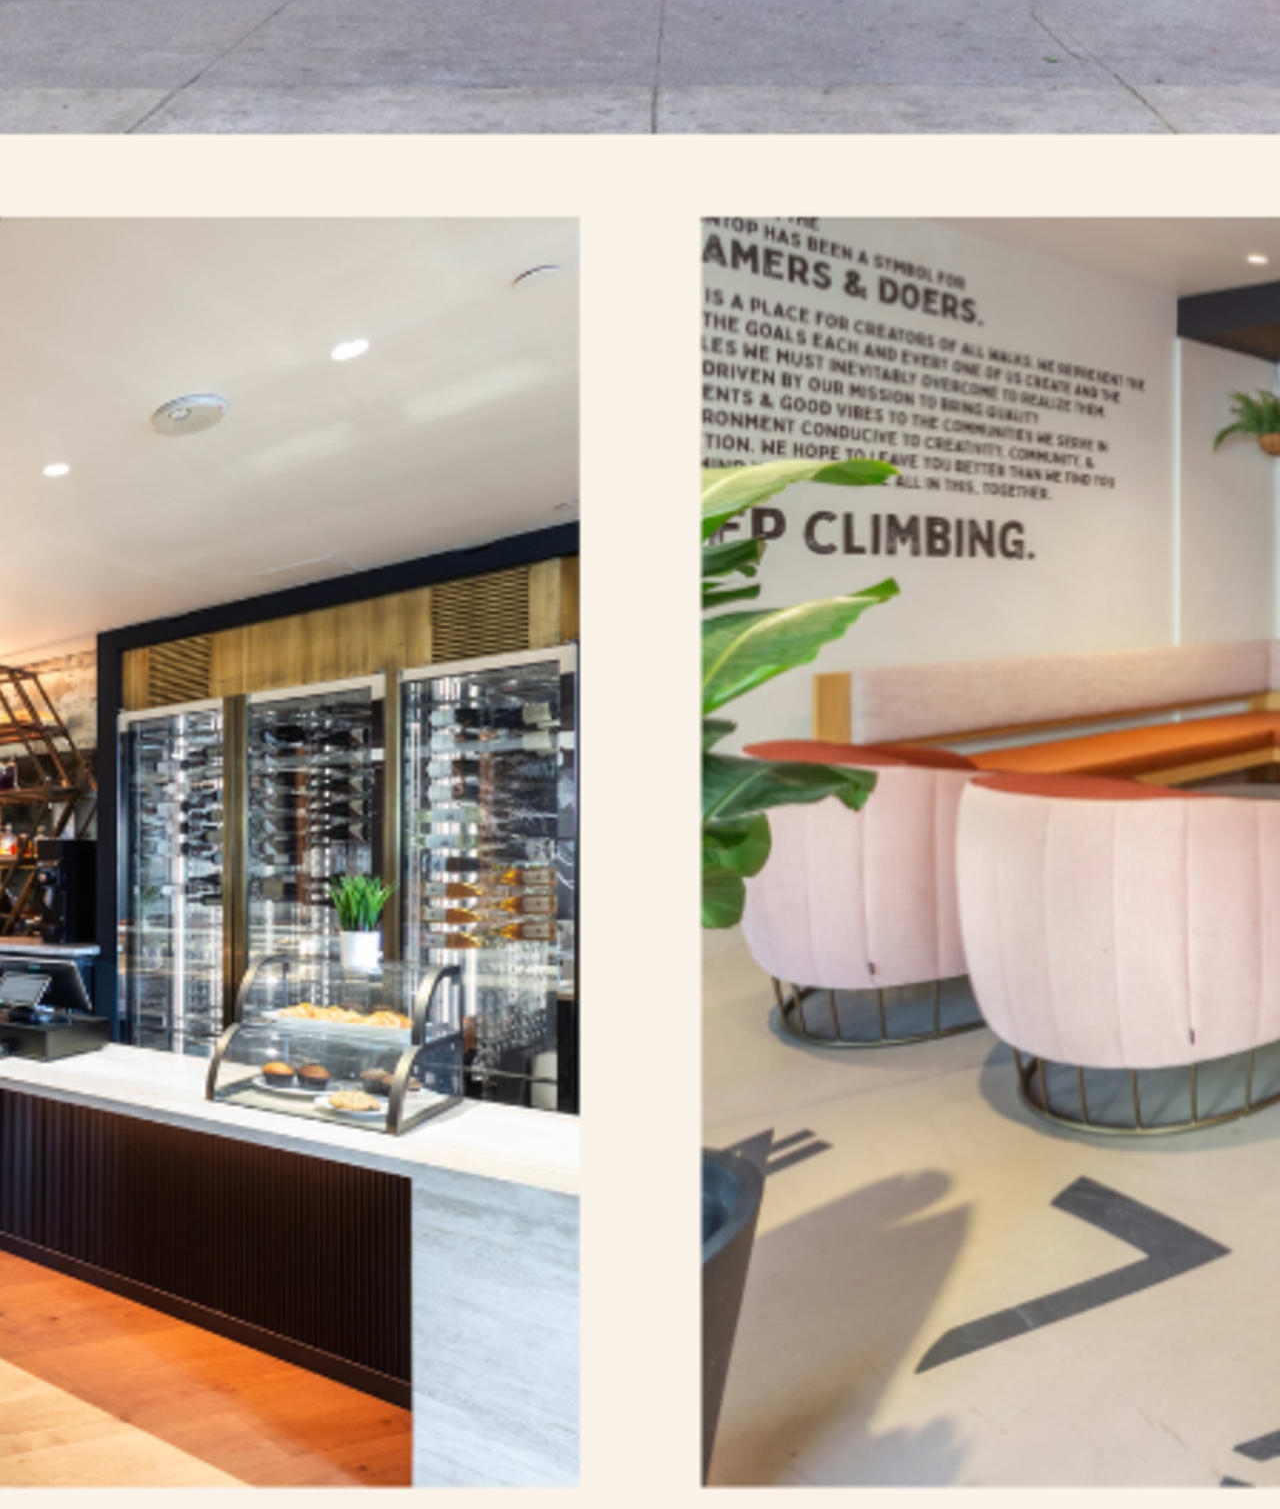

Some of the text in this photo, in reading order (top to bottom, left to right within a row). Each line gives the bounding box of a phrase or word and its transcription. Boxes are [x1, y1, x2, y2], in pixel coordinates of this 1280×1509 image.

[702, 234, 984, 327] AMERS & DOERS.
[764, 226, 800, 247] HAS
[806, 237, 853, 260] BEEN
[856, 249, 868, 264] A
[873, 254, 934, 281] SYMBOL
[937, 270, 966, 289] FOR
[703, 311, 738, 333] THE
[745, 319, 806, 345] GOALS
[813, 332, 860, 355] EACH
[863, 341, 898, 362] AND
[901, 349, 949, 372] EVERY
[952, 358, 980, 378] ONE
[705, 287, 724, 307] IS
[731, 292, 744, 311] A
[750, 296, 809, 324] PLACE
[814, 310, 849, 332] FOR
[853, 318, 935, 349] CREATORS
[938, 336, 955, 354] OF
[961, 341, 983, 359] ALL
[702, 360, 775, 386] DRIVEN
[780, 373, 803, 390] BY
[808, 377, 845, 396] OUR
[849, 384, 916, 406] MISSION
[743, 343, 769, 361] WE
[776, 348, 822, 370] MUST
[829, 358, 917, 386] INEVITABLY
[921, 374, 998, 399] OVERCOME
[702, 386, 754, 408] ENTS
[759, 394, 773, 410] &
[780, 397, 832, 417] GOOD
[837, 404, 884, 424] VIBES
[889, 412, 908, 427] TO
[912, 415, 939, 431] THE
[702, 409, 795, 435] RONMENT
[800, 422, 898, 447] CONDUCIVE
[902, 434, 921, 449] TO
[761, 440, 787, 456] WE
[793, 444, 841, 462] HOPE
[923, 457, 952, 473] YOU
[804, 510, 1036, 561] CLIMBING.
